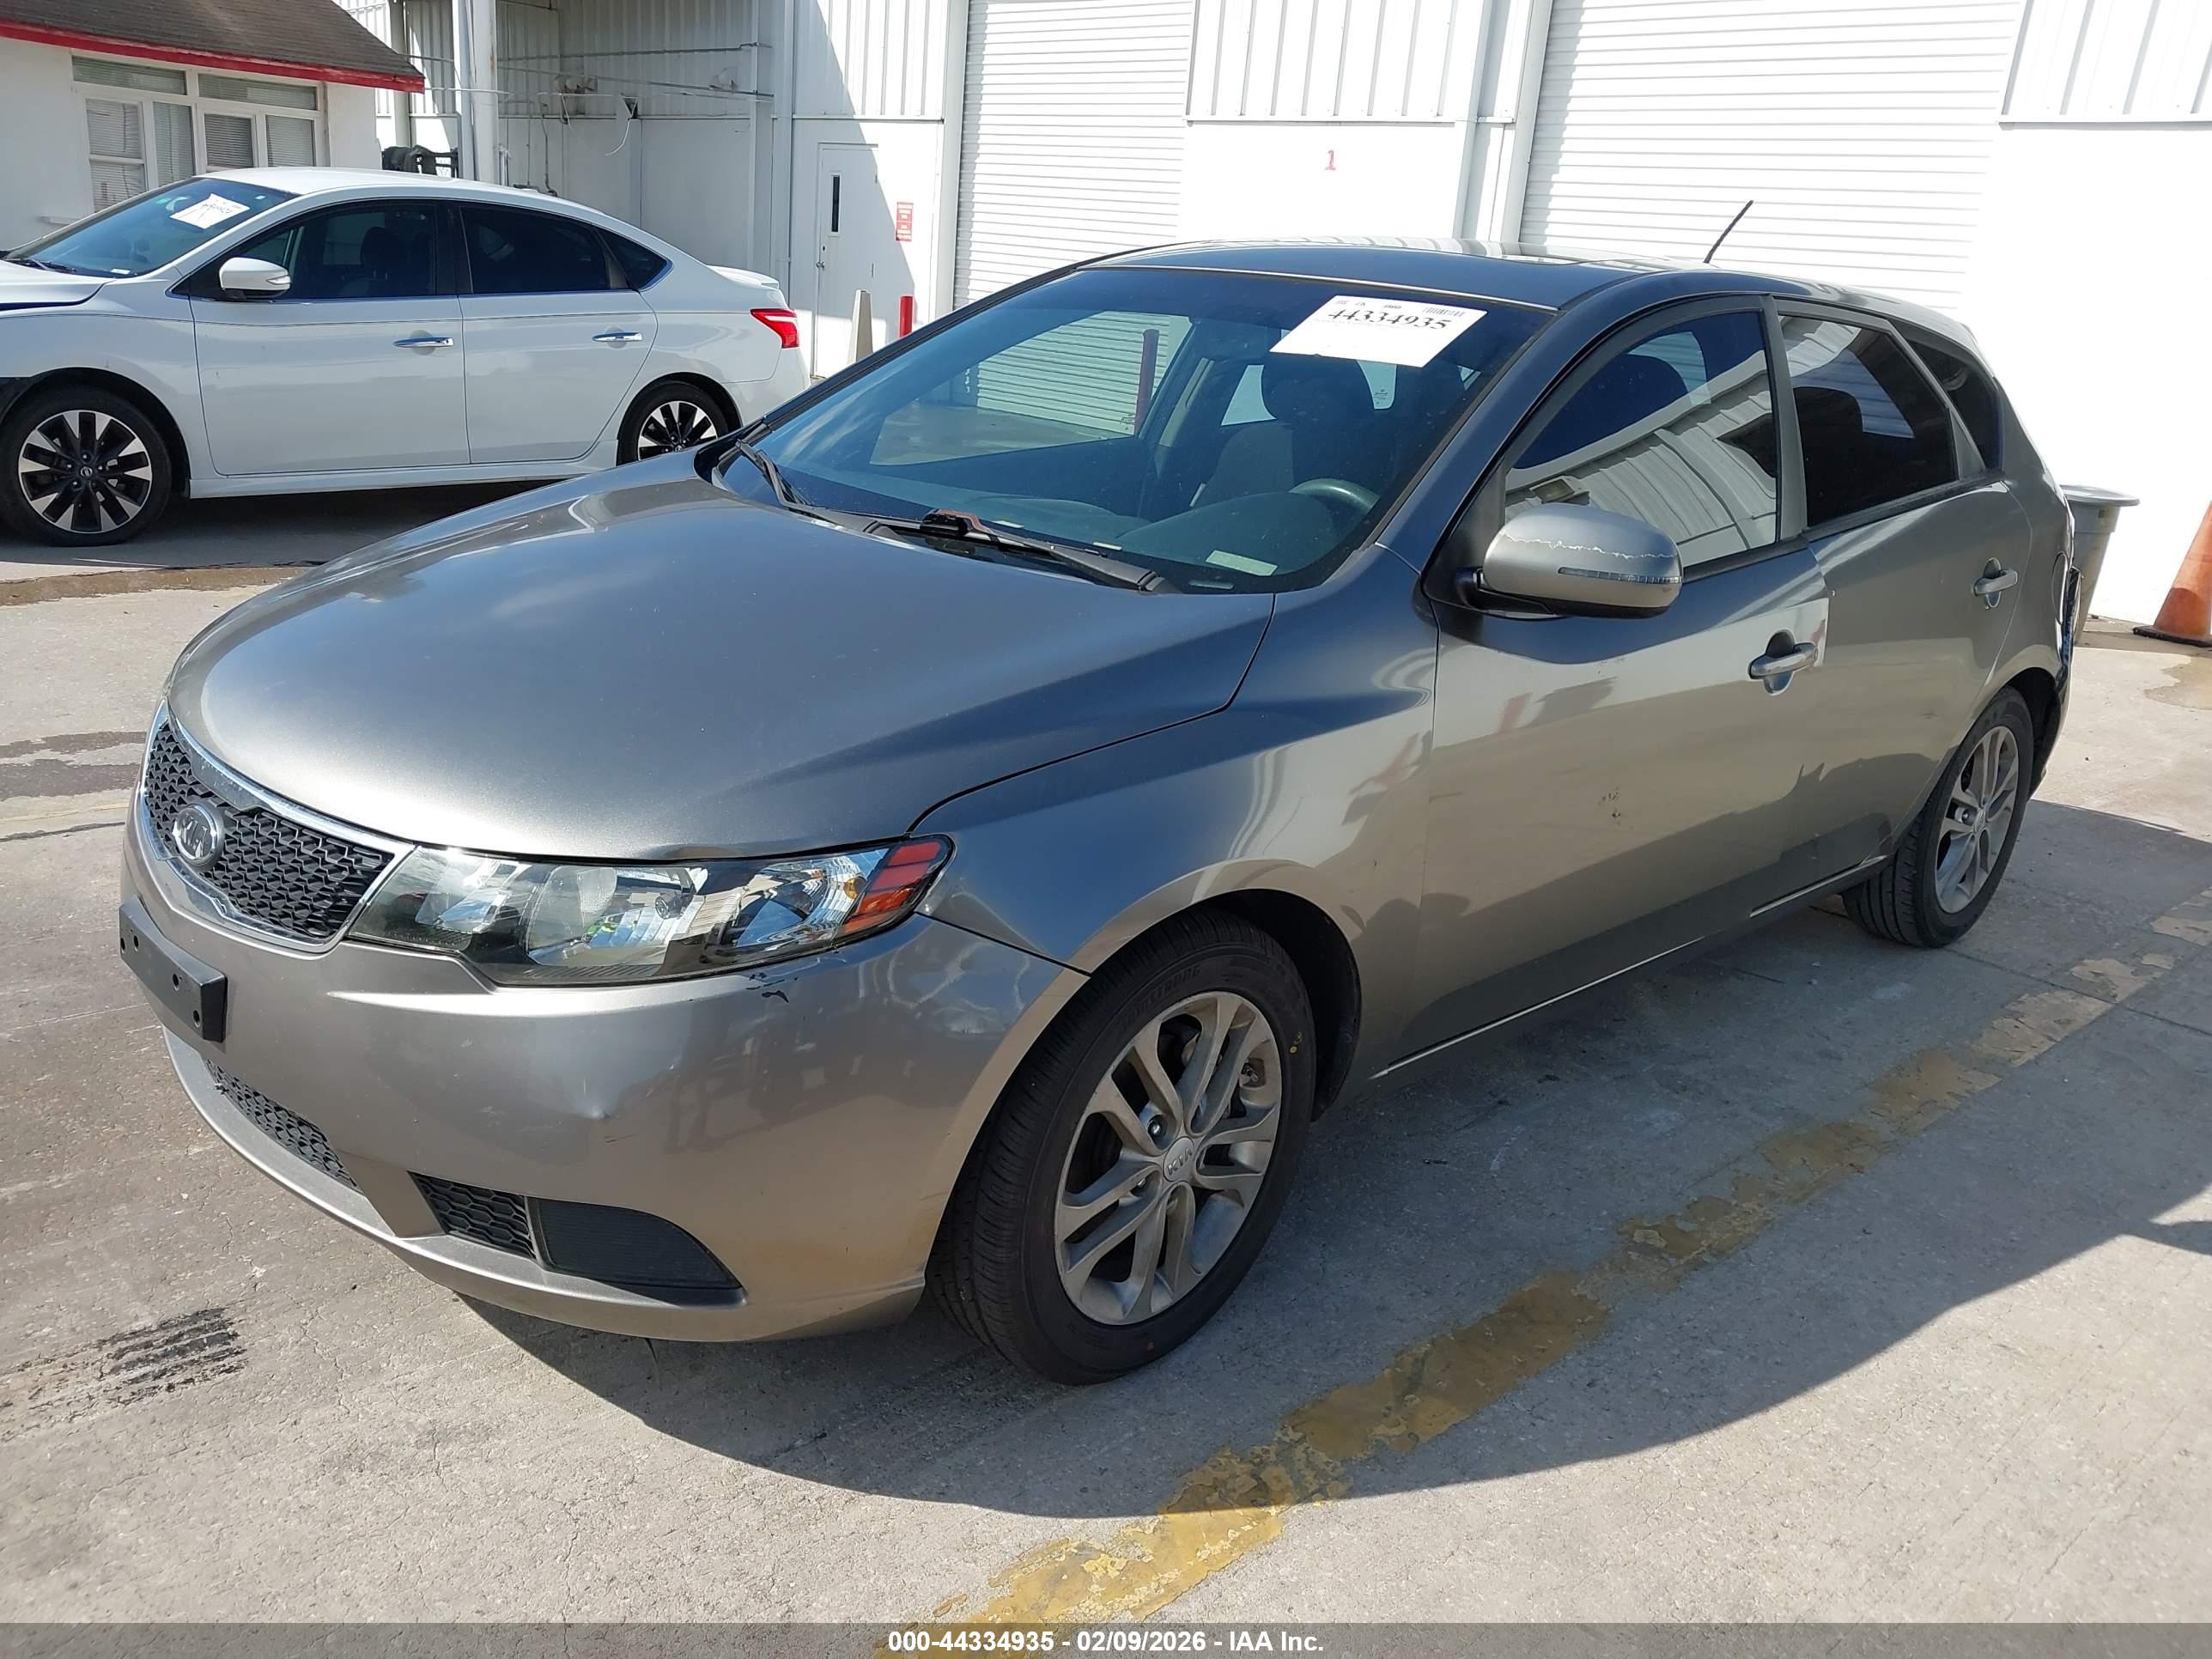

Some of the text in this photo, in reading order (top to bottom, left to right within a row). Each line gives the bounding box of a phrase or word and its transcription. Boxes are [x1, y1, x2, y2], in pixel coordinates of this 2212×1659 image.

[1325, 149, 1336, 171] 1
[1328, 308, 1451, 330] 44334935
[1167, 1147, 1193, 1176] KIA
